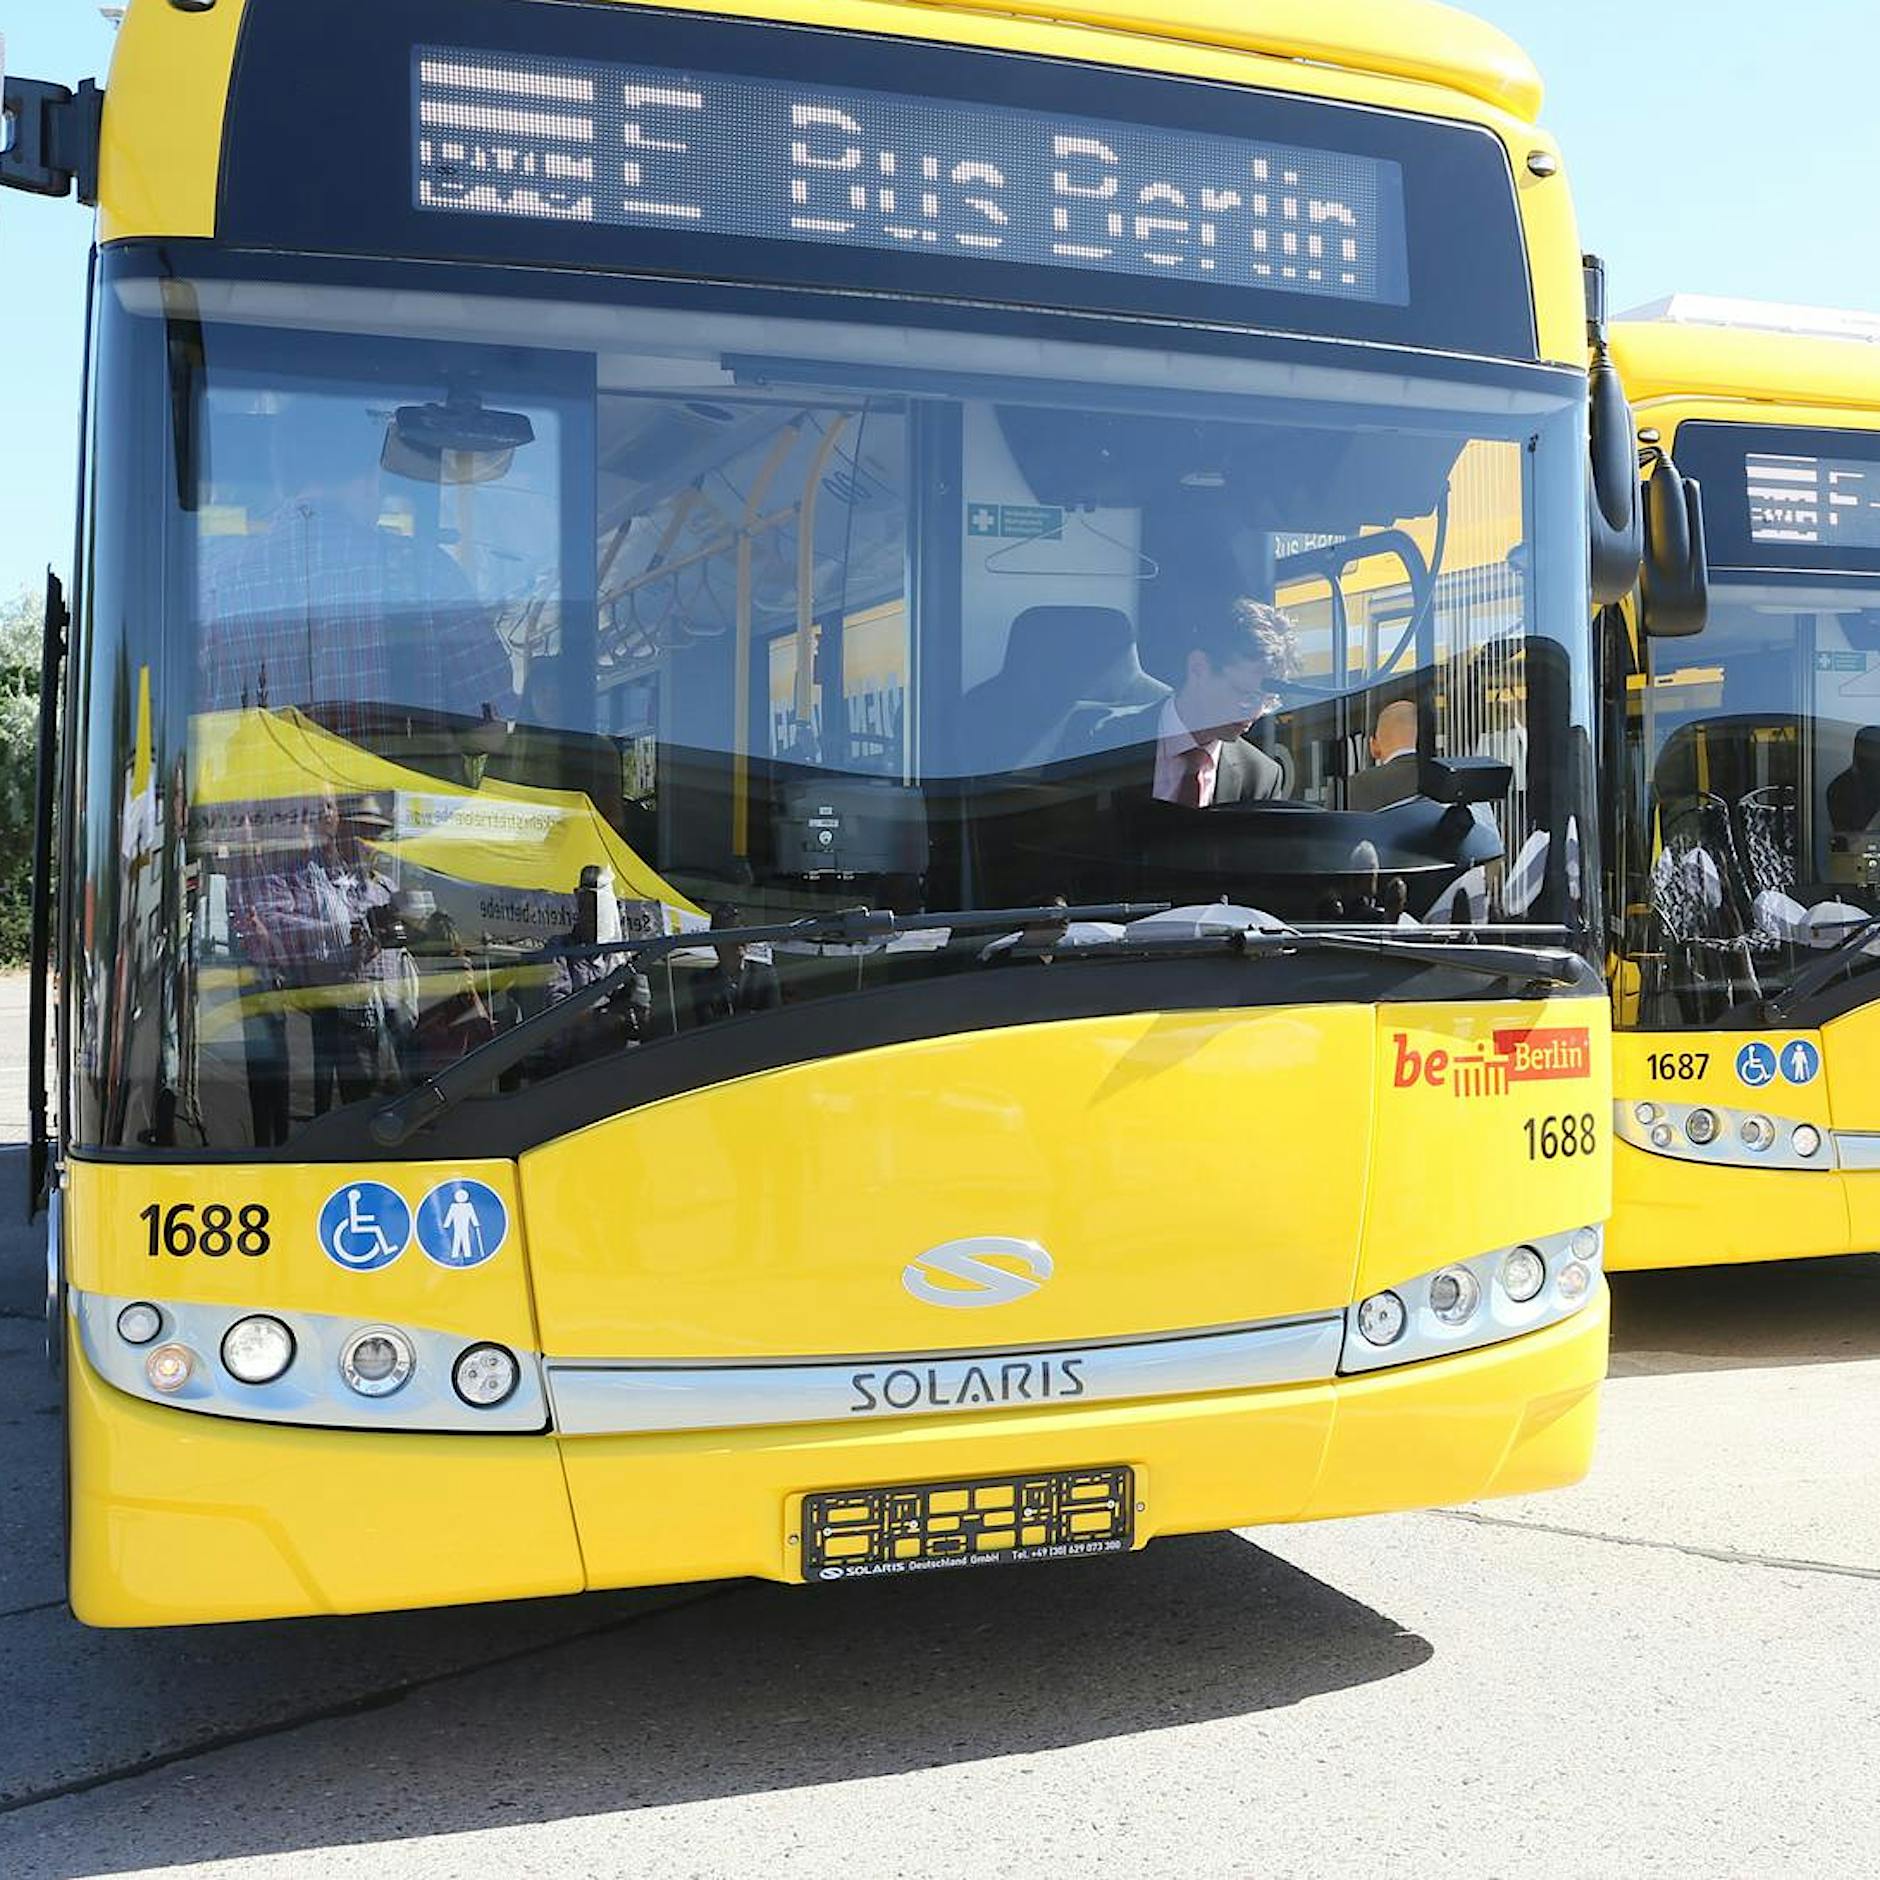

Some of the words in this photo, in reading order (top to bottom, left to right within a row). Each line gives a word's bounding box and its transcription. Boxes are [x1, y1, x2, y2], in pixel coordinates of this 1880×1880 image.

[790, 103, 1009, 248] Bus
[1053, 135, 1357, 284] Berlin
[1393, 1034, 1449, 1088] be
[1513, 1040, 1583, 1072] Berlin
[1646, 1053, 1710, 1081] 1687
[1522, 1113, 1597, 1161] 1688
[139, 1203, 271, 1257] 1688
[850, 1358, 1084, 1412] SOLARIS
[845, 1562, 906, 1577] SOLARIS
[908, 1556, 967, 1571] Deutschland
[970, 1552, 1000, 1565] GmbH
